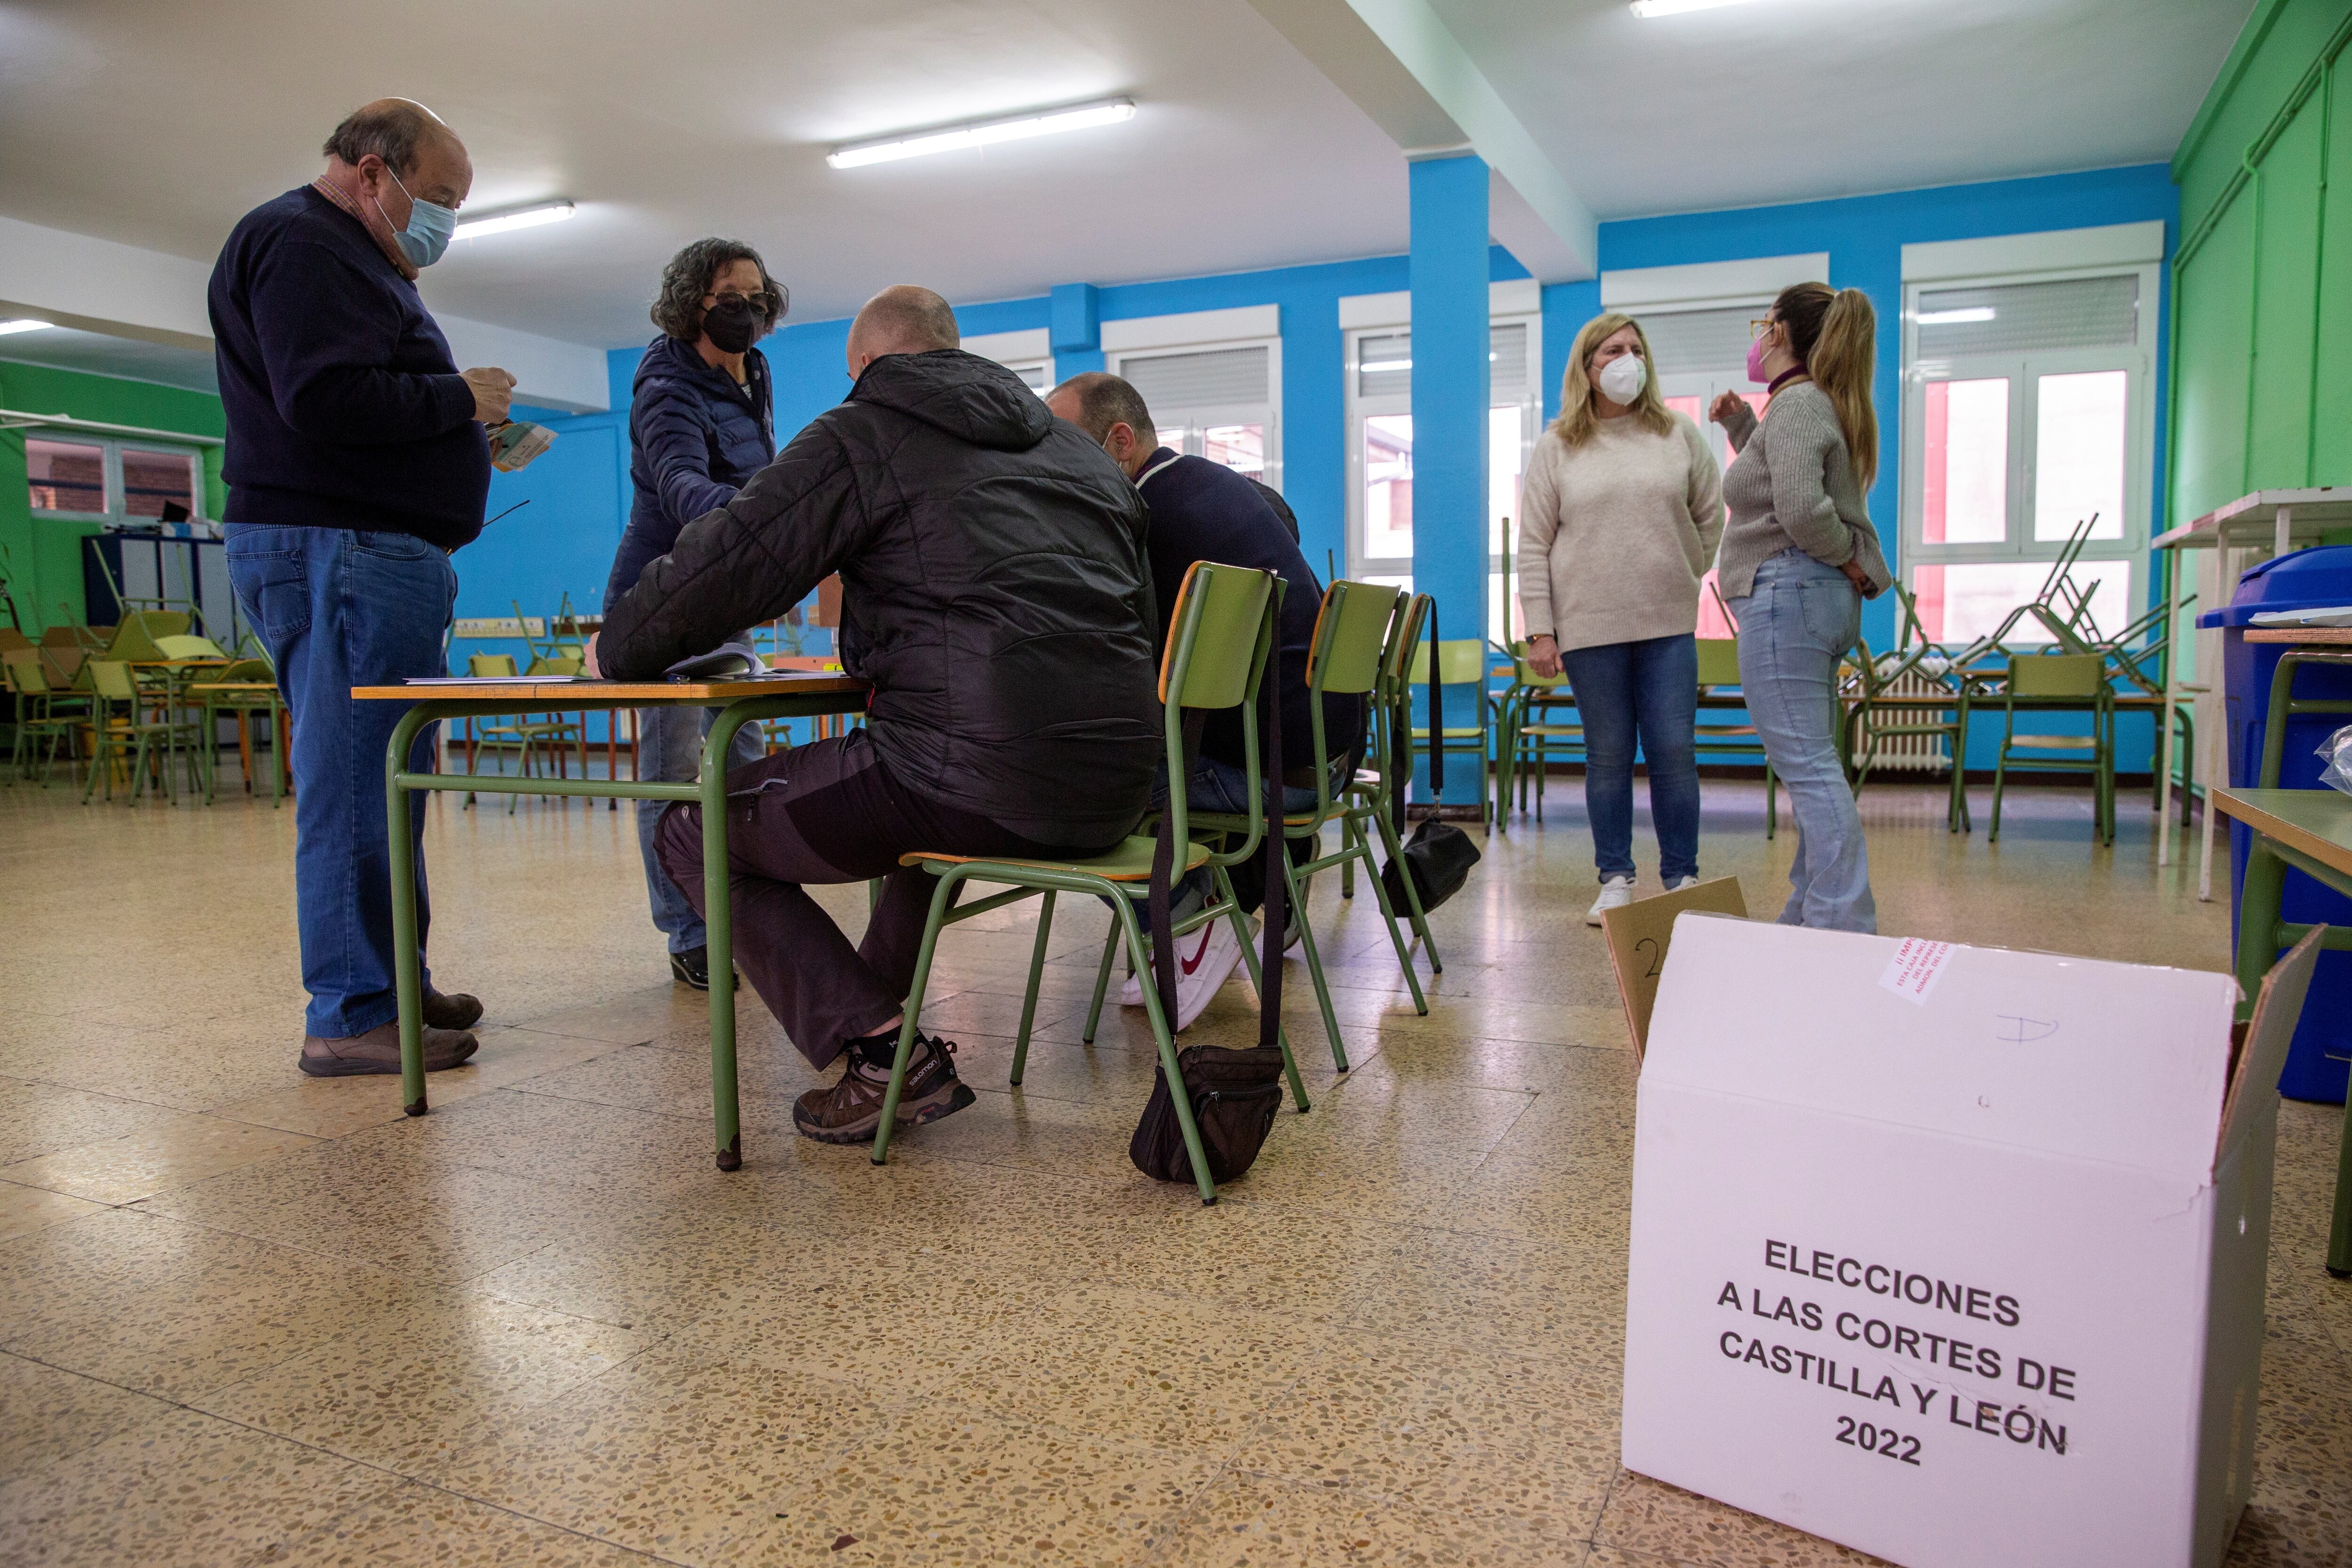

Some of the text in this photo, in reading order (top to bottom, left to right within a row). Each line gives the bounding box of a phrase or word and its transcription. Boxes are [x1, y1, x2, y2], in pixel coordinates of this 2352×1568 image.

[1897, 939, 1928, 986] ESTA CAJA INCL
[1912, 968, 1923, 979] DEL
[1931, 956, 1941, 967] DEL
[1765, 1239, 2020, 1327] ELECCIONES
[1717, 1281, 2076, 1401] A LAS CORTES DE
[1720, 1331, 2068, 1456] CASTILLA Y LEÓN
[1835, 1415, 1922, 1466] 2022
